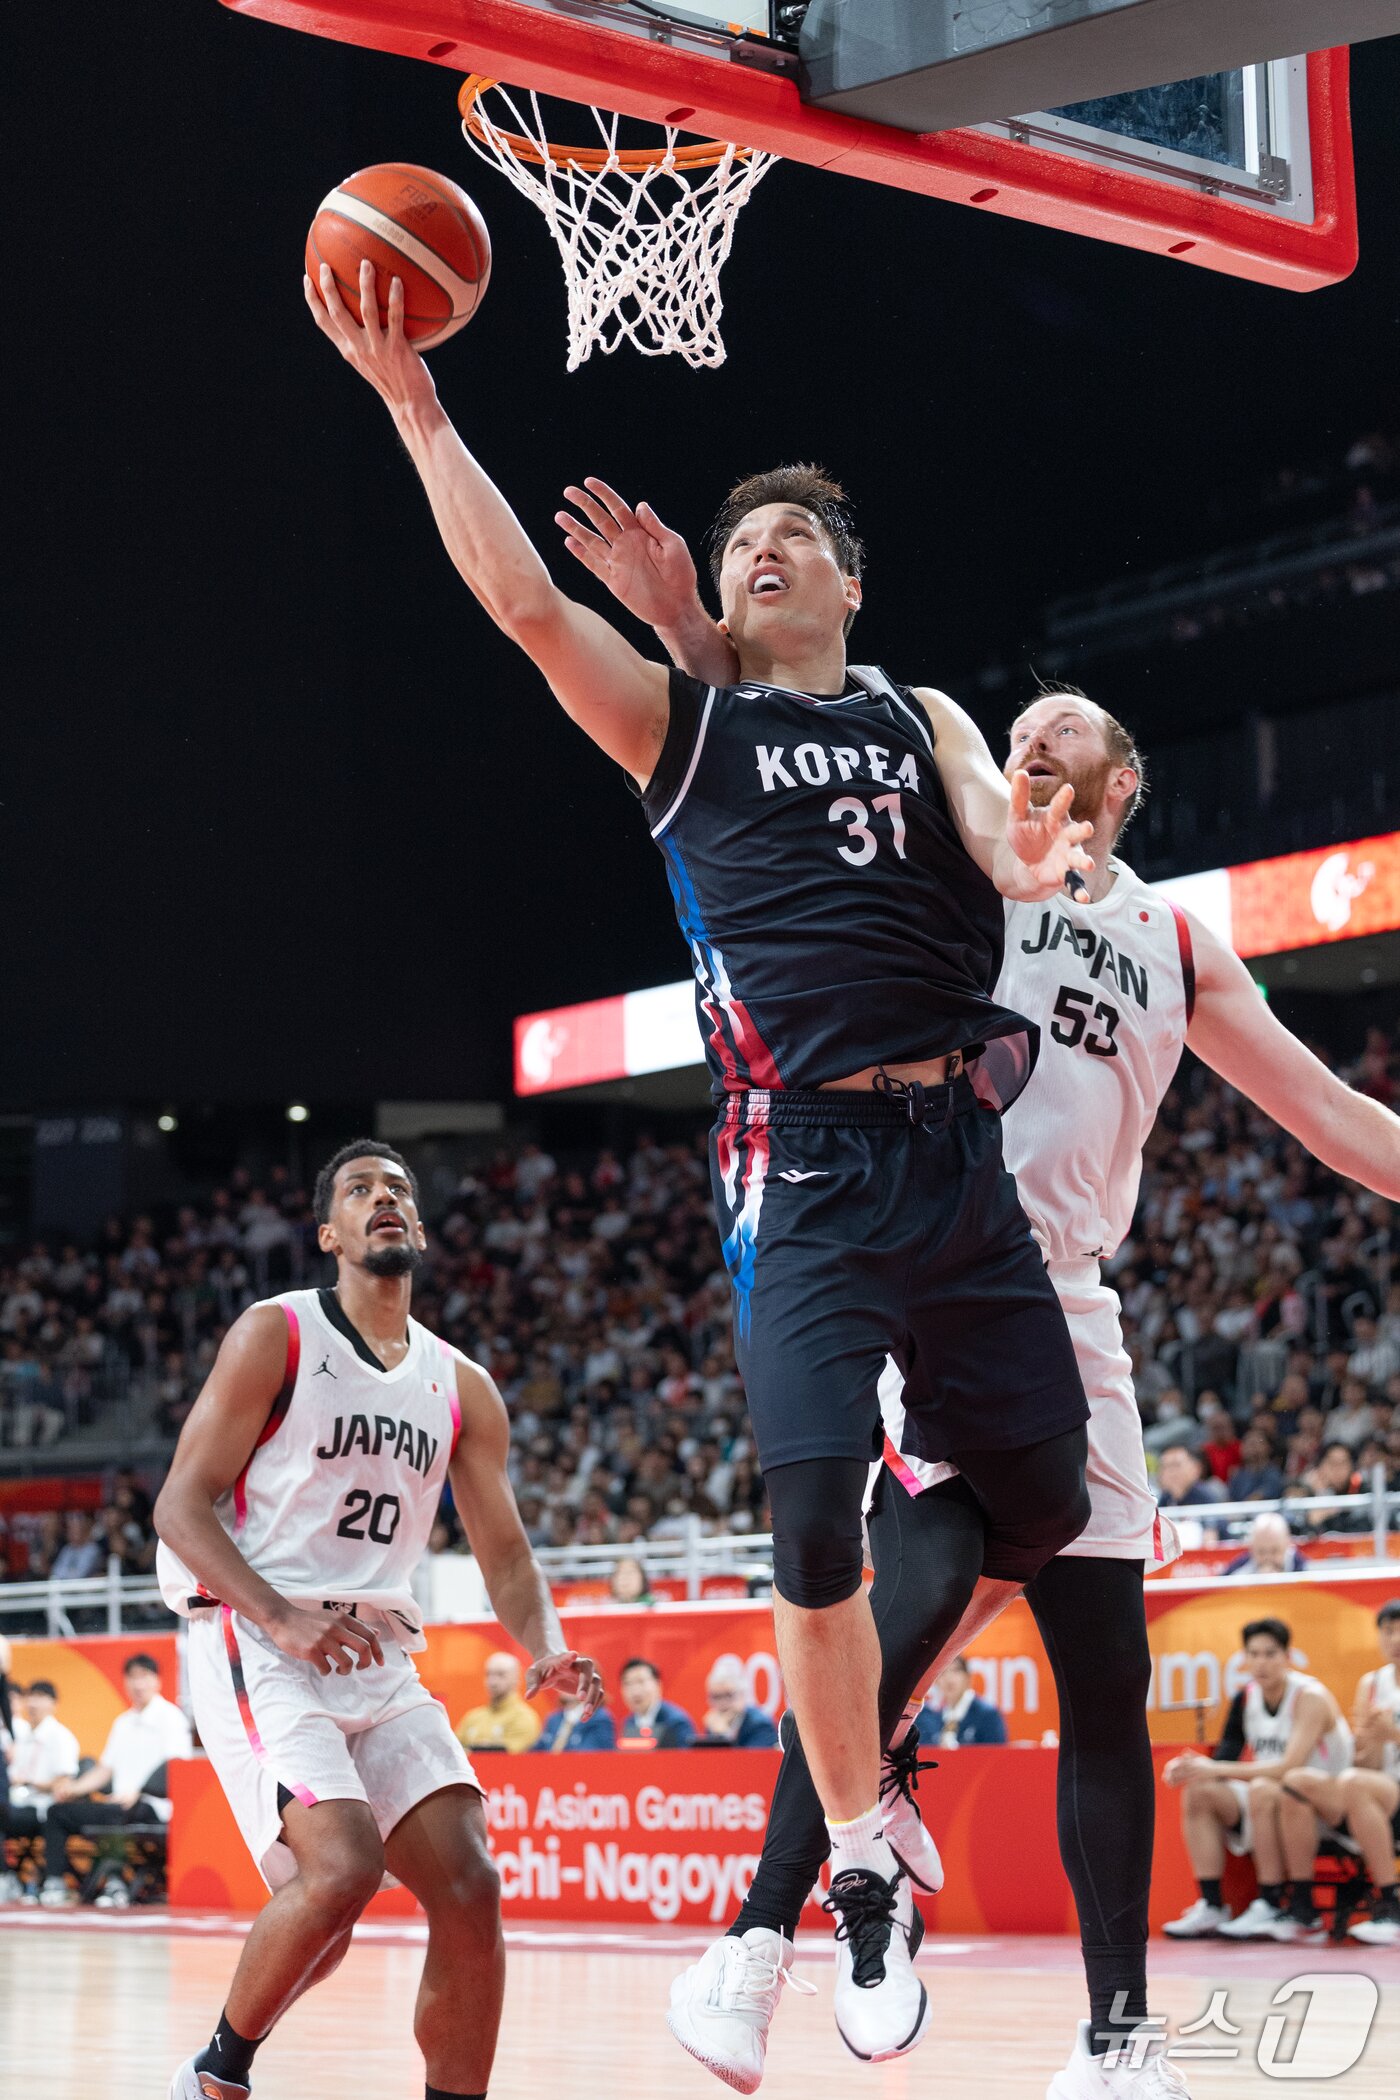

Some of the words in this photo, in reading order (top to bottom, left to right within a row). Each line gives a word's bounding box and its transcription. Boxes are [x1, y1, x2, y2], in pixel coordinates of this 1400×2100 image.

[755, 742, 920, 795] KOREA
[828, 792, 907, 867] 31
[1020, 910, 1148, 1012] JAPAN
[1050, 985, 1120, 1057] 53
[316, 1414, 438, 1478] JAPAN
[336, 1488, 400, 1545] 20
[483, 1783, 529, 1831] th
[533, 1782, 630, 1831] Asian
[636, 1785, 767, 1832] Games
